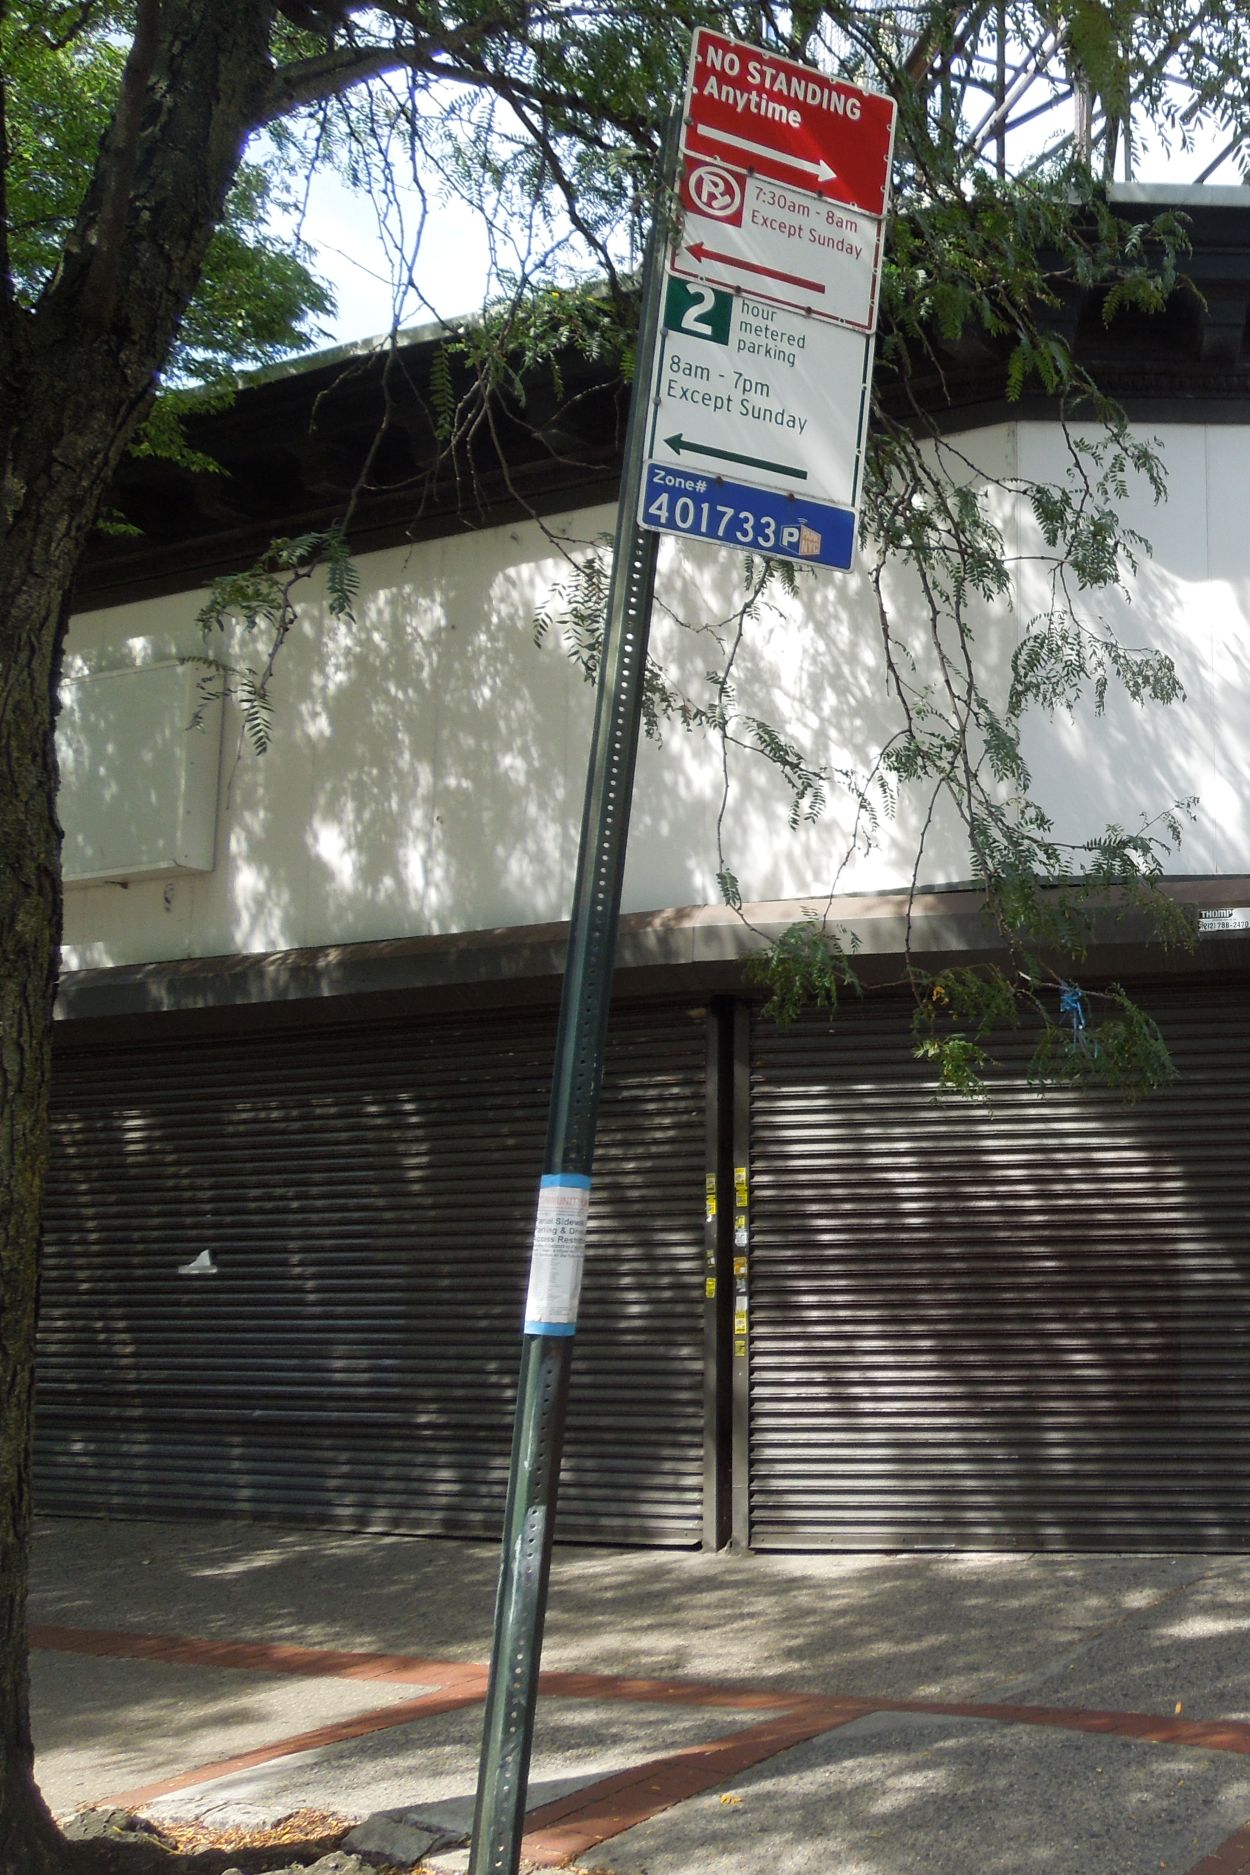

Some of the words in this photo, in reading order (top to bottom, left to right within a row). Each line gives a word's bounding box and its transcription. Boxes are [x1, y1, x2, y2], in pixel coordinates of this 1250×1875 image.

[703, 75, 802, 128] Anytime
[705, 45, 740, 76] NO
[747, 61, 862, 120] STANDING
[754, 185, 810, 218] 7:30am
[825, 210, 858, 233] 8am
[750, 209, 803, 239] Except
[808, 228, 863, 260] Sunday
[680, 282, 715, 336] 2
[741, 300, 777, 322] hour
[737, 337, 796, 368] parking
[739, 320, 806, 349] metered
[670, 354, 710, 381] 8am
[733, 371, 770, 398] 7pm
[667, 379, 732, 413] Except
[739, 399, 808, 435] Sunday
[652, 469, 708, 494] Zone#
[648, 492, 776, 548] 401733
[782, 527, 799, 546] P
